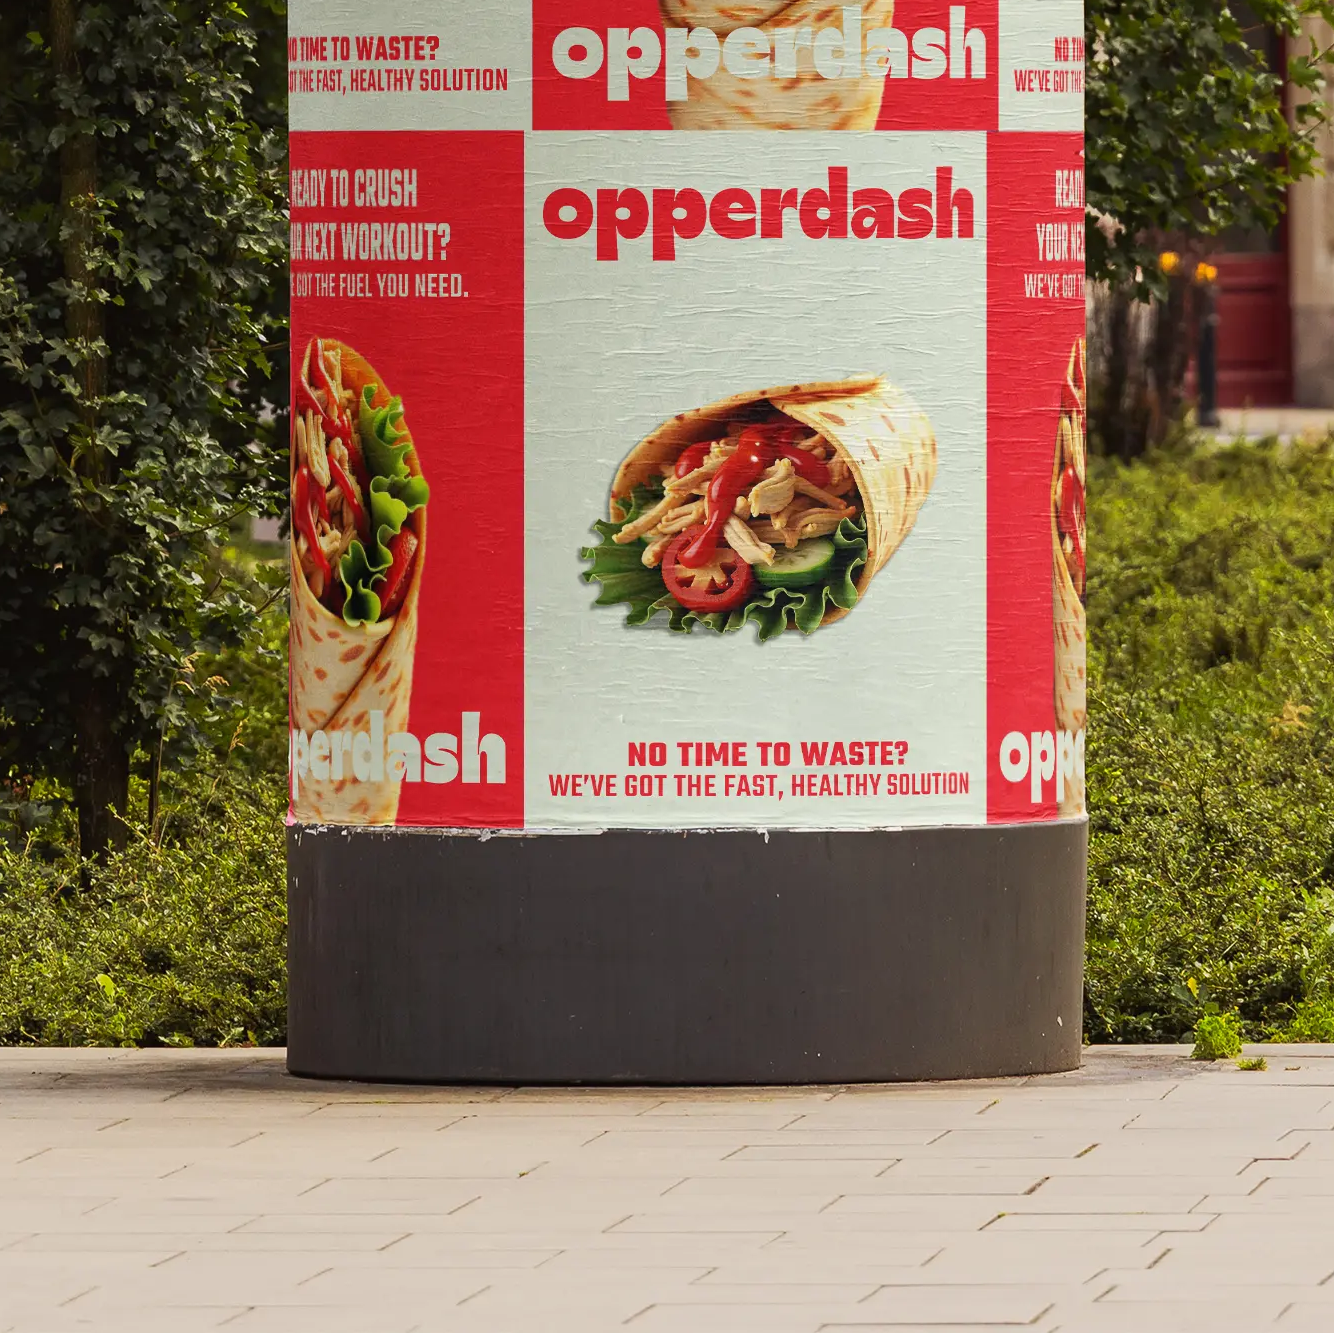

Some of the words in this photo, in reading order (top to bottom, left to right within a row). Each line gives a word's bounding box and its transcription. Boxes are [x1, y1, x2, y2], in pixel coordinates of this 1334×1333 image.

[299, 36, 328, 62] TIME
[331, 36, 350, 62] TO
[355, 35, 440, 61] WASTE?
[552, 5, 987, 102] opperdash
[1054, 36, 1069, 62] NO
[298, 69, 314, 93] THE
[317, 68, 347, 96] FAST,
[351, 68, 415, 92] HEALTHY
[419, 67, 508, 92] SOLUTION
[1013, 69, 1051, 93] WE'VE
[1053, 69, 1069, 94] GOT
[1071, 69, 1082, 94] THE
[291, 169, 327, 207] READY
[330, 169, 349, 207] TO
[354, 168, 418, 207] CRUSH
[1055, 169, 1084, 207] READY
[542, 166, 974, 262] opperdash
[304, 222, 337, 261] NEXT
[340, 222, 451, 261] WORKOUT?
[1036, 222, 1069, 261] YOUR
[296, 273, 312, 297] GOT
[315, 273, 336, 297] THE
[339, 273, 373, 297] FUEL
[376, 273, 409, 297] YOU
[415, 273, 469, 298] NEED.
[1024, 273, 1059, 298] WE'VE
[1062, 273, 1076, 298] GOT
[288, 710, 506, 801] perdash
[628, 741, 668, 767] NO
[676, 741, 748, 767] TIME
[756, 741, 791, 767] TO
[800, 740, 909, 767] WASTE?
[548, 773, 617, 797] WE'VE
[624, 774, 668, 797] GOT
[673, 774, 717, 797] THE
[724, 773, 784, 801] FAST,
[791, 773, 882, 797] HEALTHY
[886, 771, 970, 796] SOLUTION
